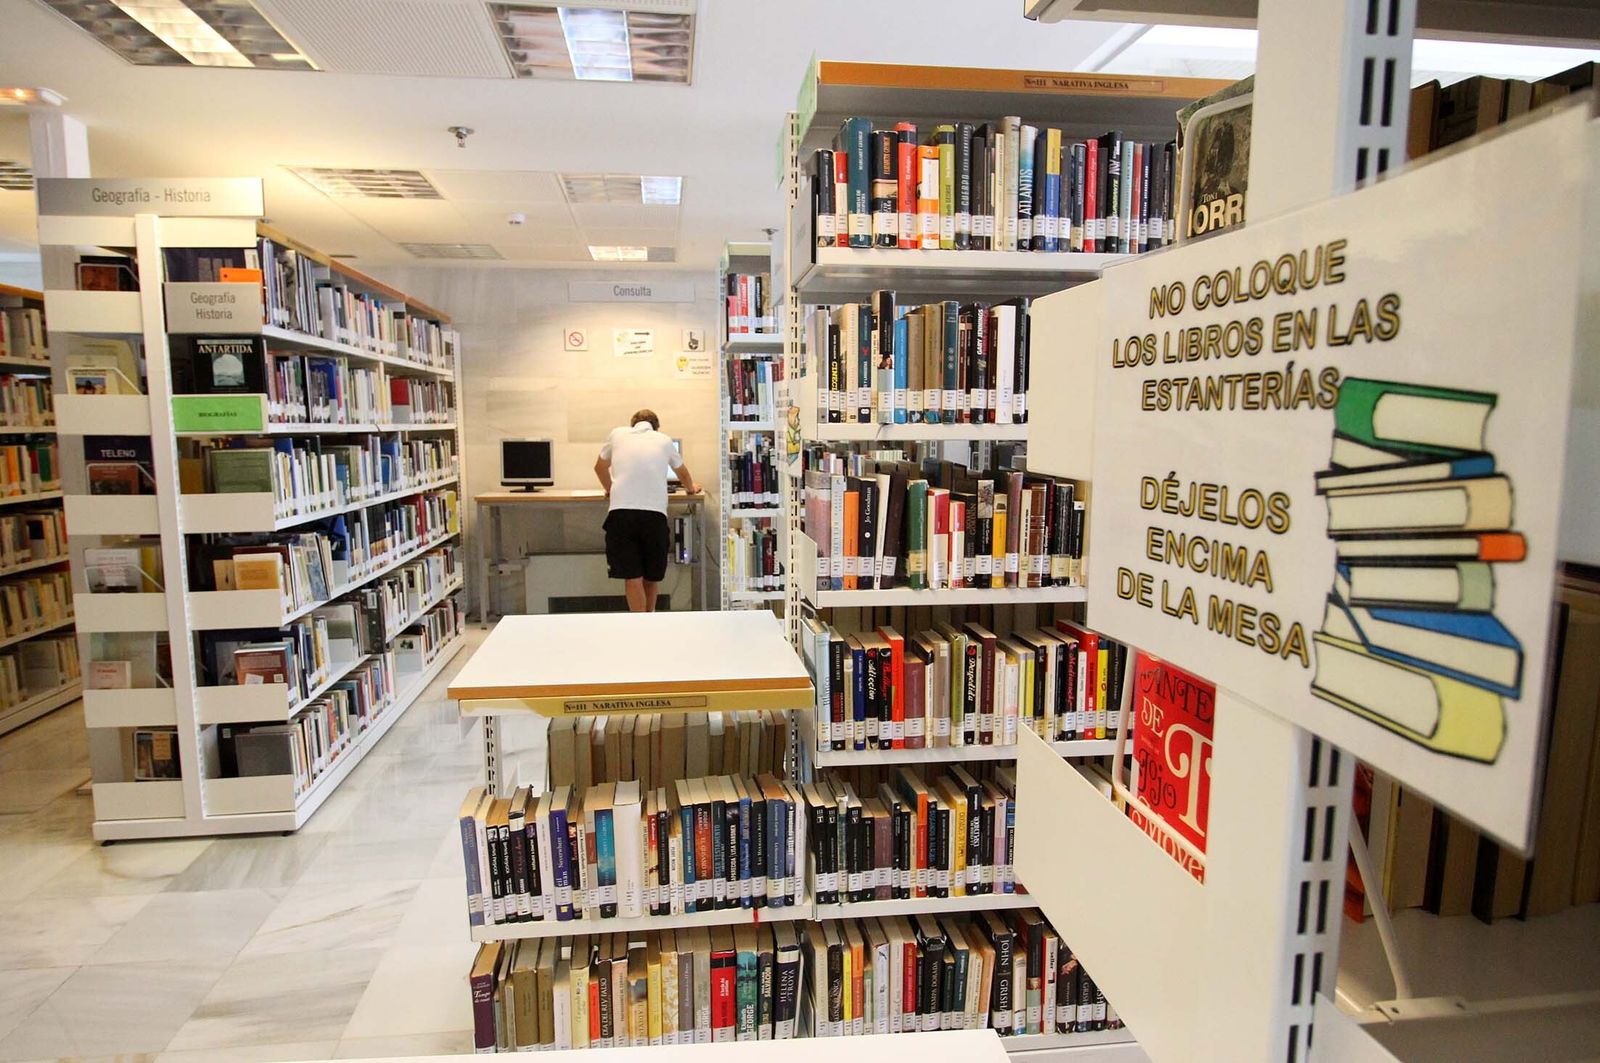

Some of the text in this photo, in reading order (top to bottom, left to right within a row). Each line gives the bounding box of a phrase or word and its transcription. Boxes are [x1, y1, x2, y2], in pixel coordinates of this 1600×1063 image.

[1052, 79, 1093, 88] NARATIVA
[1093, 80, 1129, 89] INGLESA
[164, 187, 211, 203] Historia
[961, 174, 969, 206] CUERPO
[1019, 168, 1032, 216] ATLANTIS
[613, 285, 652, 297] Consulta
[1149, 239, 1348, 319] NO COLOQUE
[195, 308, 233, 320] Historia
[1112, 293, 1401, 368] LOS LIBROS EN LAS
[1141, 361, 1340, 411] ESTANTERÍAS
[100, 449, 136, 458] TELENO
[864, 487, 872, 524] Jo Goodman
[1140, 471, 1291, 535] DÉJELOS
[1147, 526, 1274, 593] ENCIMA
[1117, 567, 1309, 668] DE LA MESA
[966, 656, 976, 701] Despedida
[592, 701, 634, 710] NARATIVA
[636, 699, 671, 707] INGLESA
[1142, 696, 1165, 737] DE
[1165, 723, 1214, 837] T
[1000, 939, 1009, 966] JOHN
[746, 1003, 754, 1033] GEORGE
